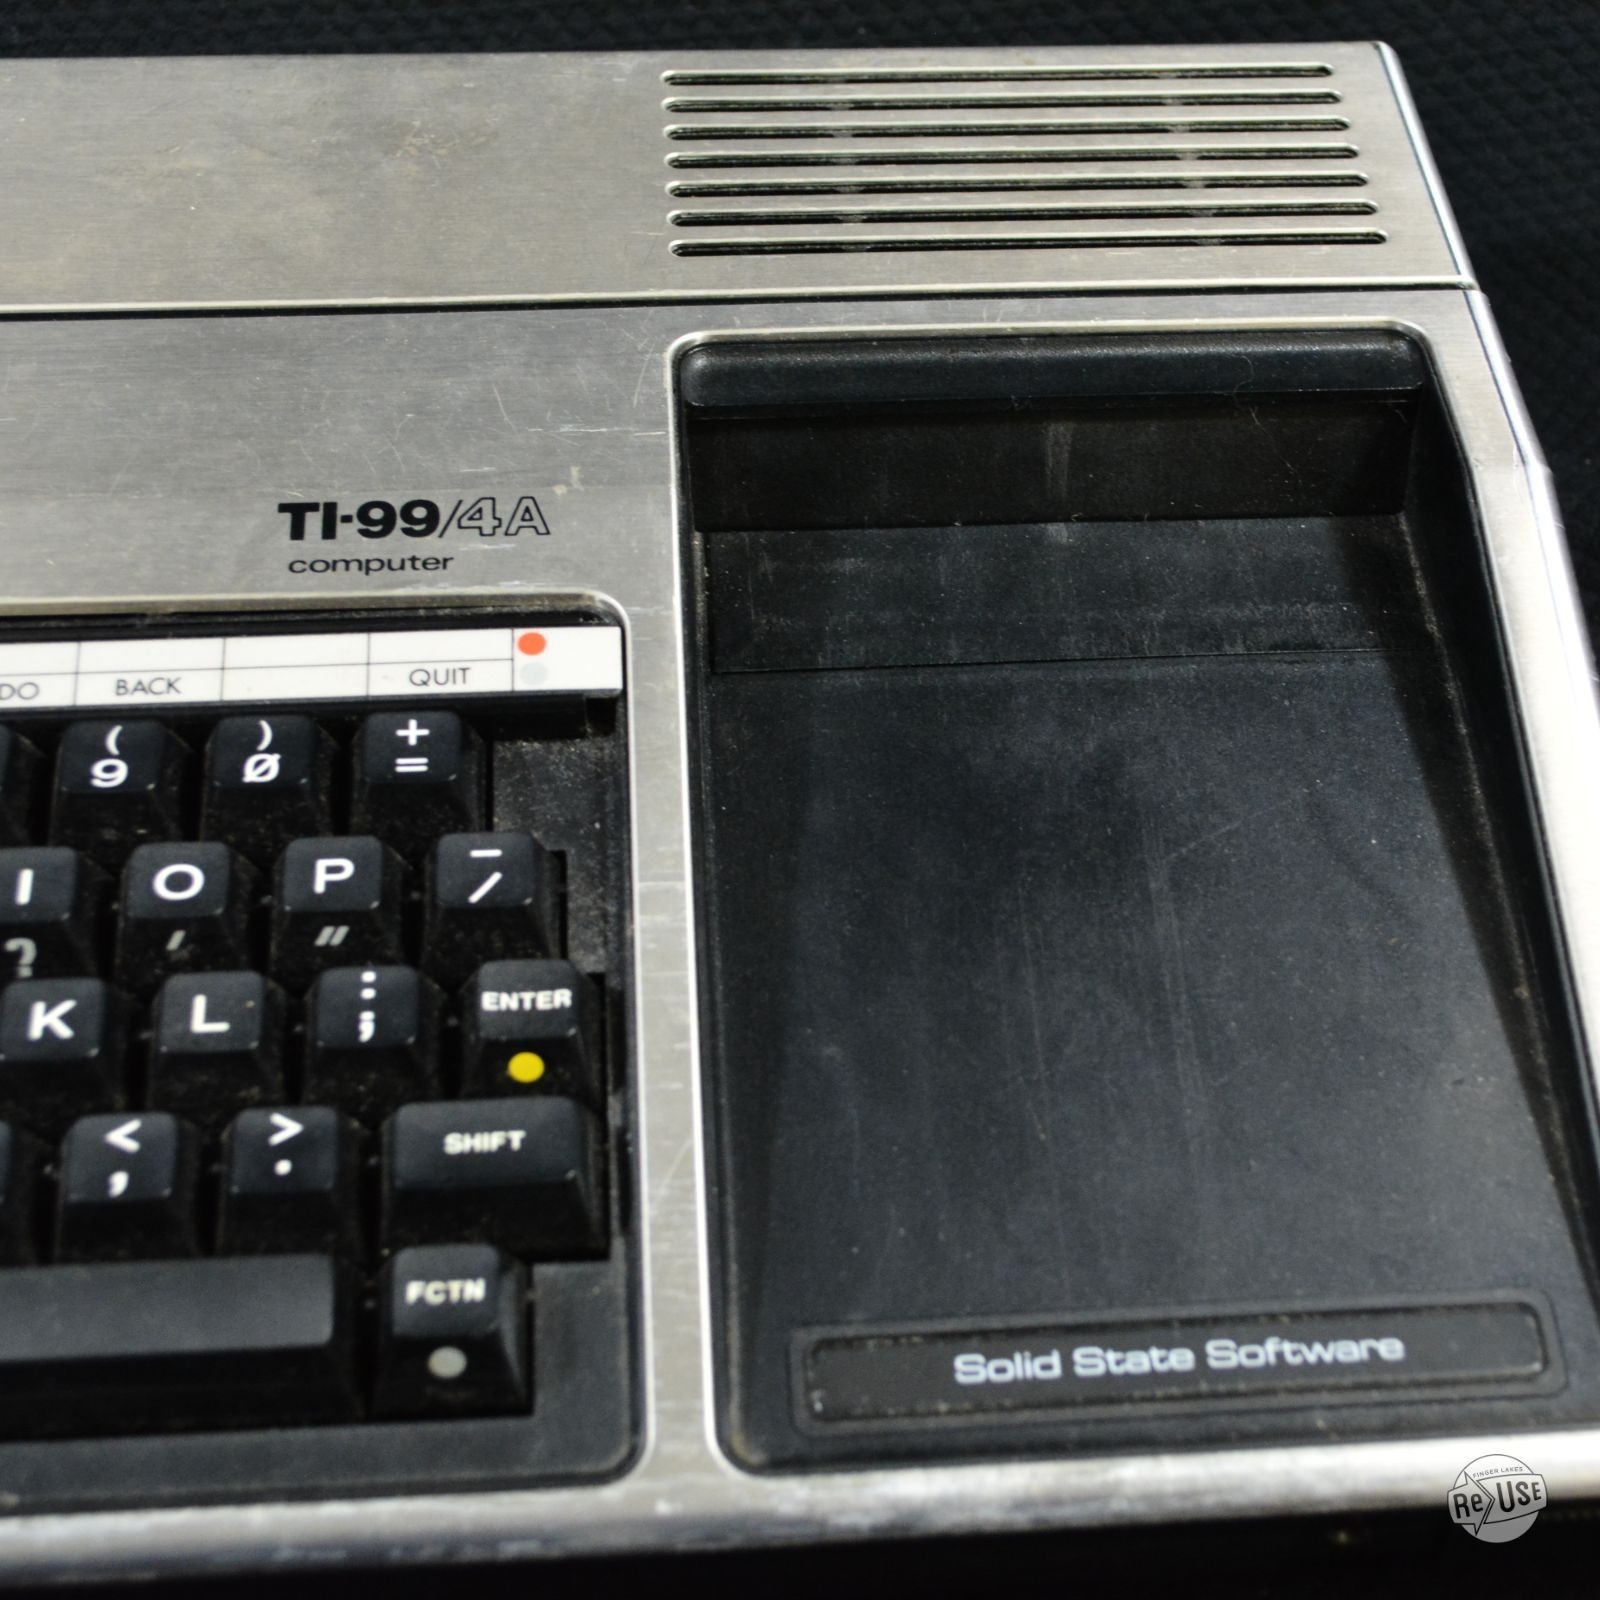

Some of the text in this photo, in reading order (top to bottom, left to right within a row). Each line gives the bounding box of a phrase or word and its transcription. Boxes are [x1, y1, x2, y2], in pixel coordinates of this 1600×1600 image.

[288, 553, 455, 576] computer
[115, 677, 182, 697] BACK
[409, 667, 471, 687] QUIT
[90, 758, 129, 789] 9
[16, 868, 34, 906] I
[313, 858, 355, 894] P
[190, 993, 231, 1034] L
[480, 988, 573, 1012] ENTER
[27, 999, 78, 1041] K
[443, 1129, 527, 1156] SHIFT
[405, 1278, 486, 1304] FCTN
[953, 1336, 1406, 1385] Solid State Software
